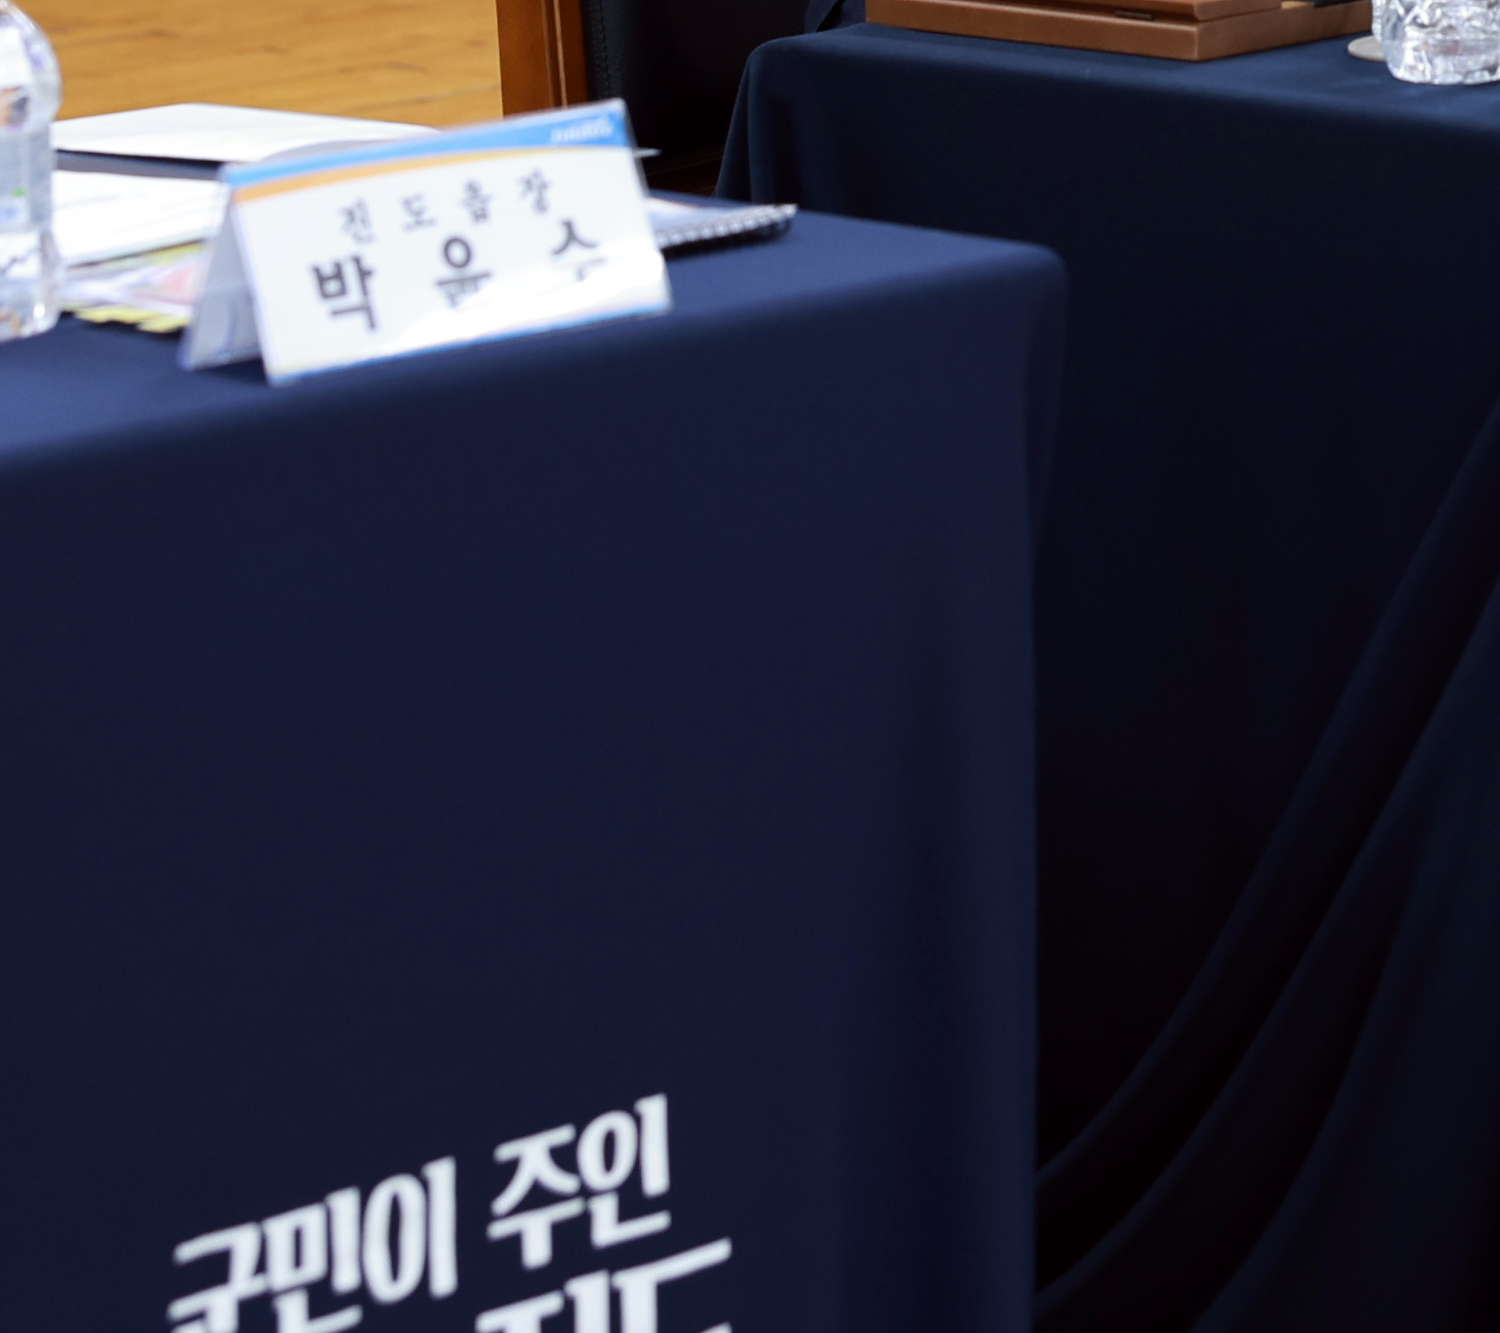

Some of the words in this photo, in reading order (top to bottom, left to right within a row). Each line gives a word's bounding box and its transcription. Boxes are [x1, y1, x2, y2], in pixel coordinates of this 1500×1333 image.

[338, 167, 555, 245] 진도읍장
[168, 1156, 458, 1333] 군민이
[486, 1092, 672, 1271] 주인
